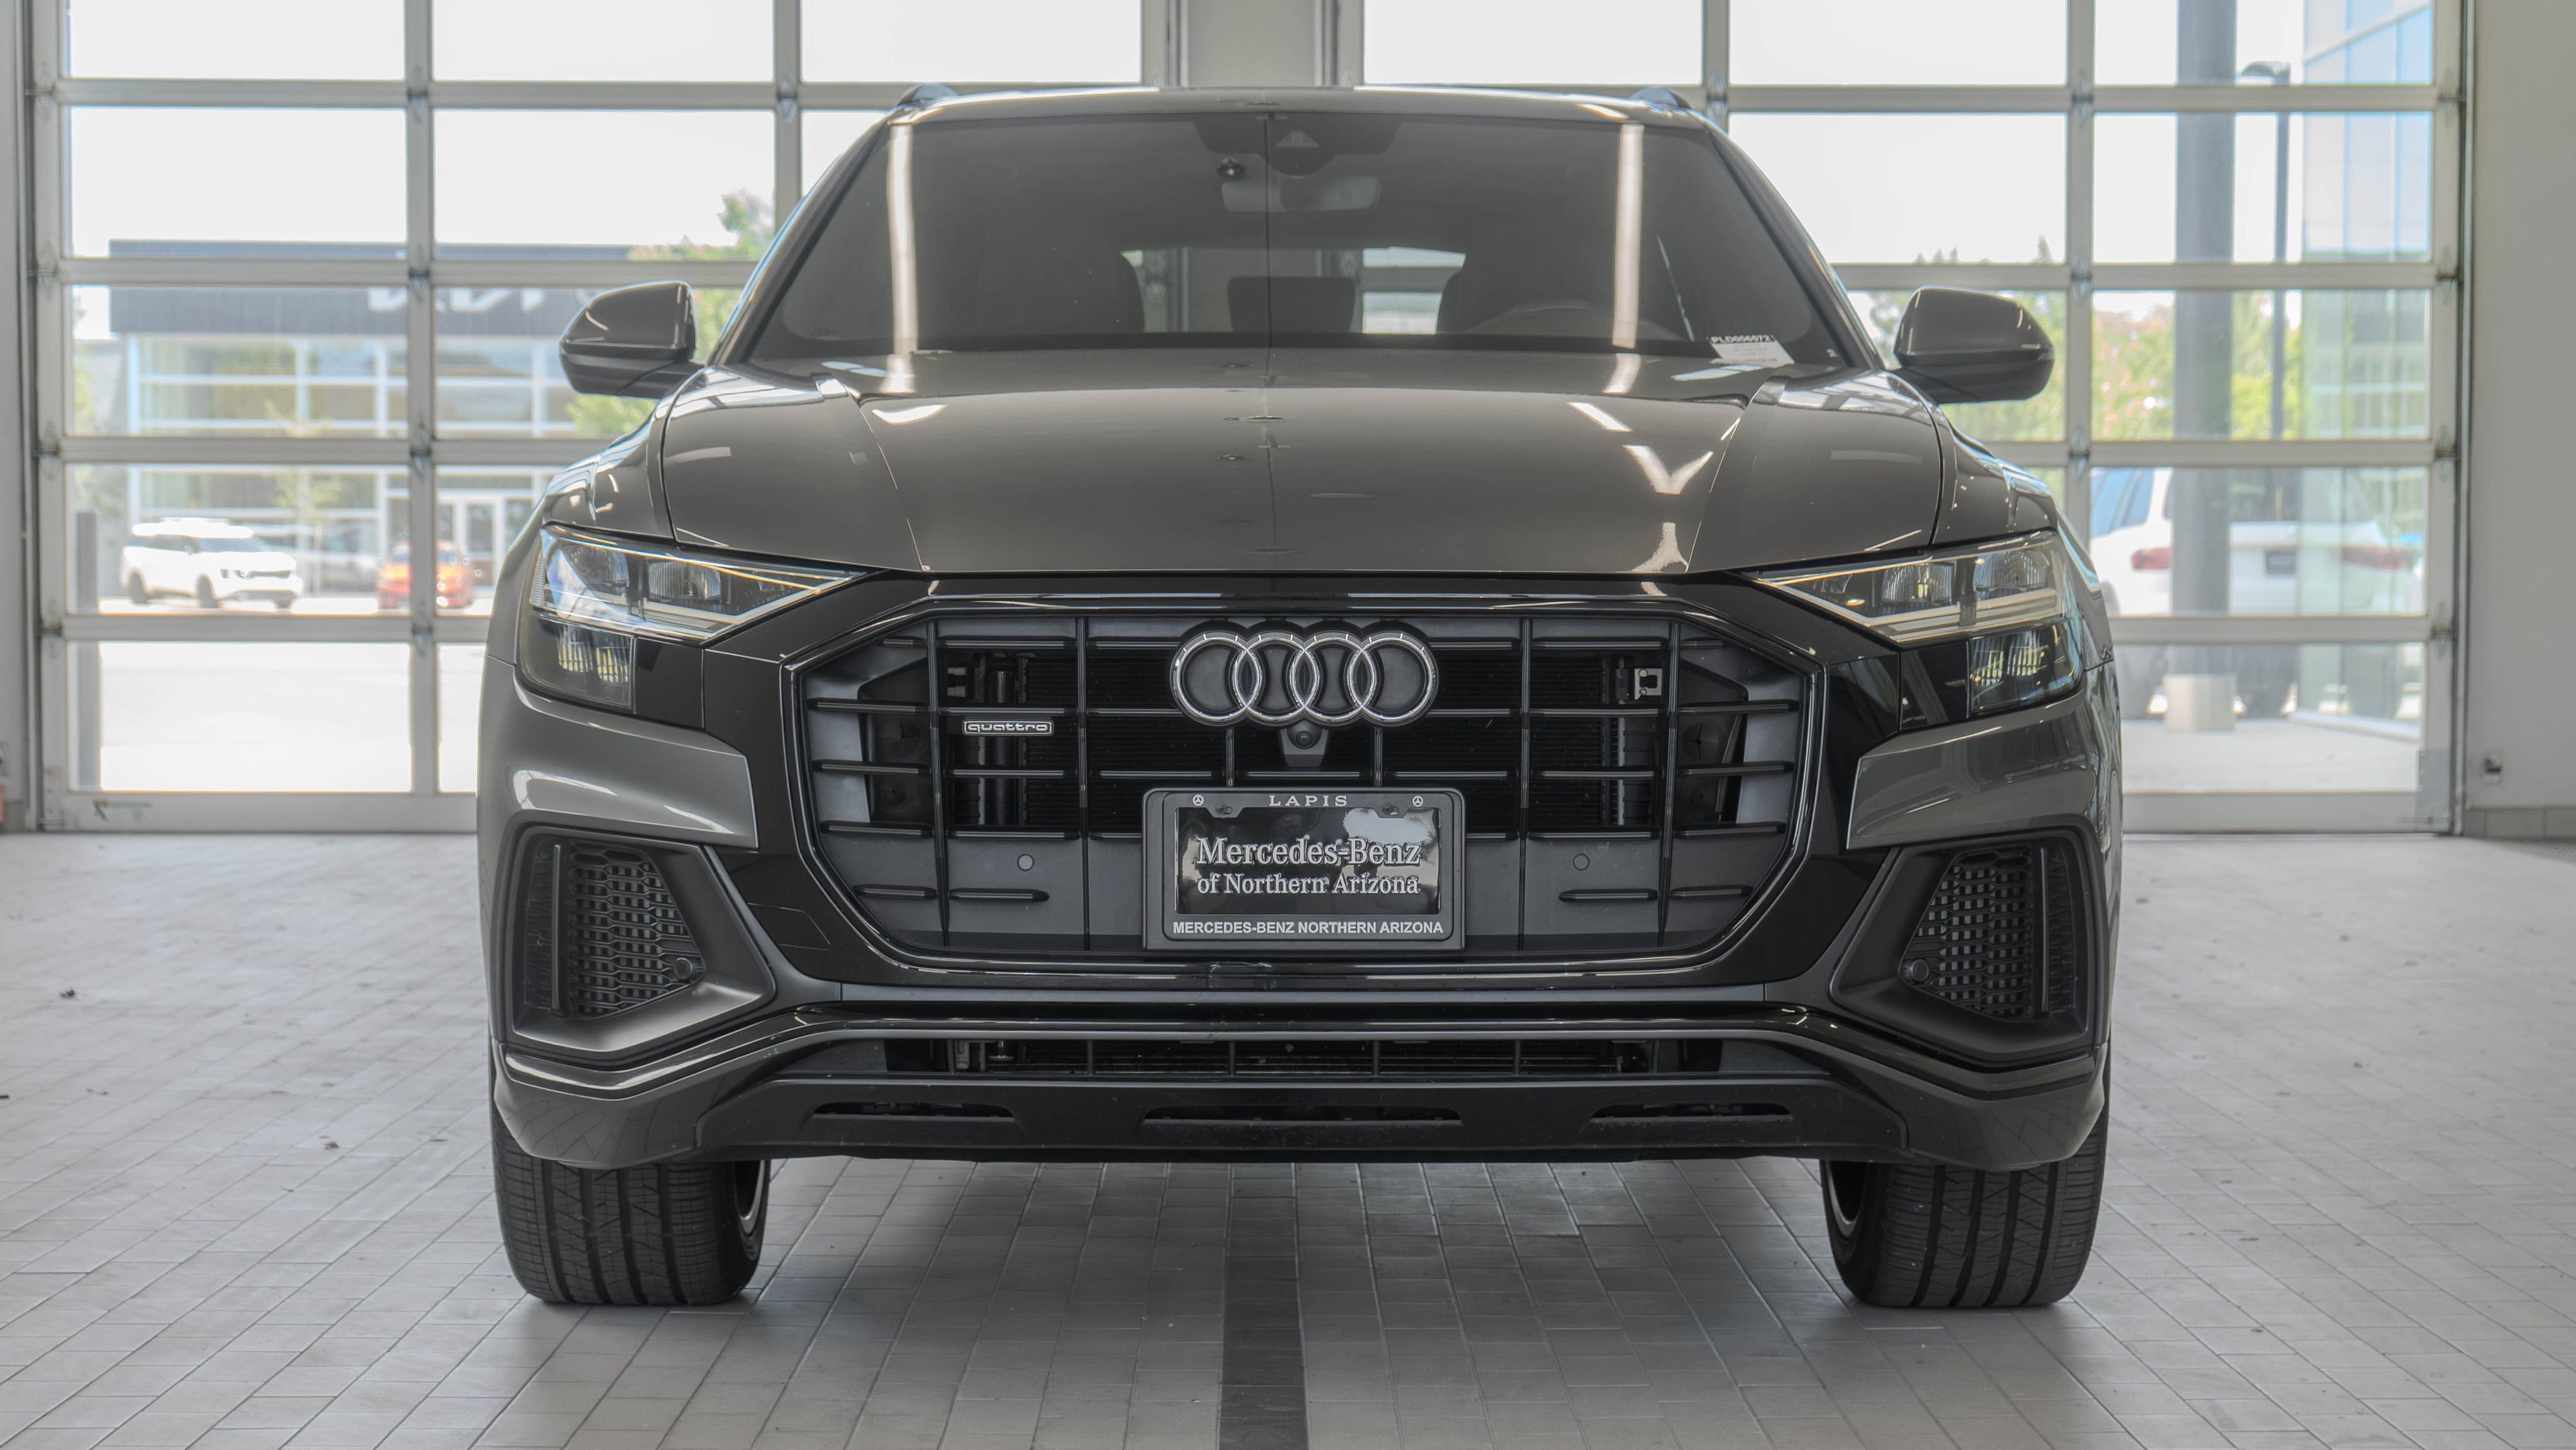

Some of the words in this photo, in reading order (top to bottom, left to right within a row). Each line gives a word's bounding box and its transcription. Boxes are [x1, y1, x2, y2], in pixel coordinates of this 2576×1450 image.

[968, 723, 1048, 732] quattro
[1269, 795, 1347, 806] LAPIS
[1197, 836, 1421, 864] Mercedes-Benz
[1197, 873, 1220, 893] of
[1224, 873, 1326, 893] Northern
[1332, 872, 1420, 893] Arizona
[1173, 921, 1294, 934] MERCEDES-BENZ
[1298, 921, 1376, 934] NORTHERN
[1379, 921, 1443, 934] ARIZONA
